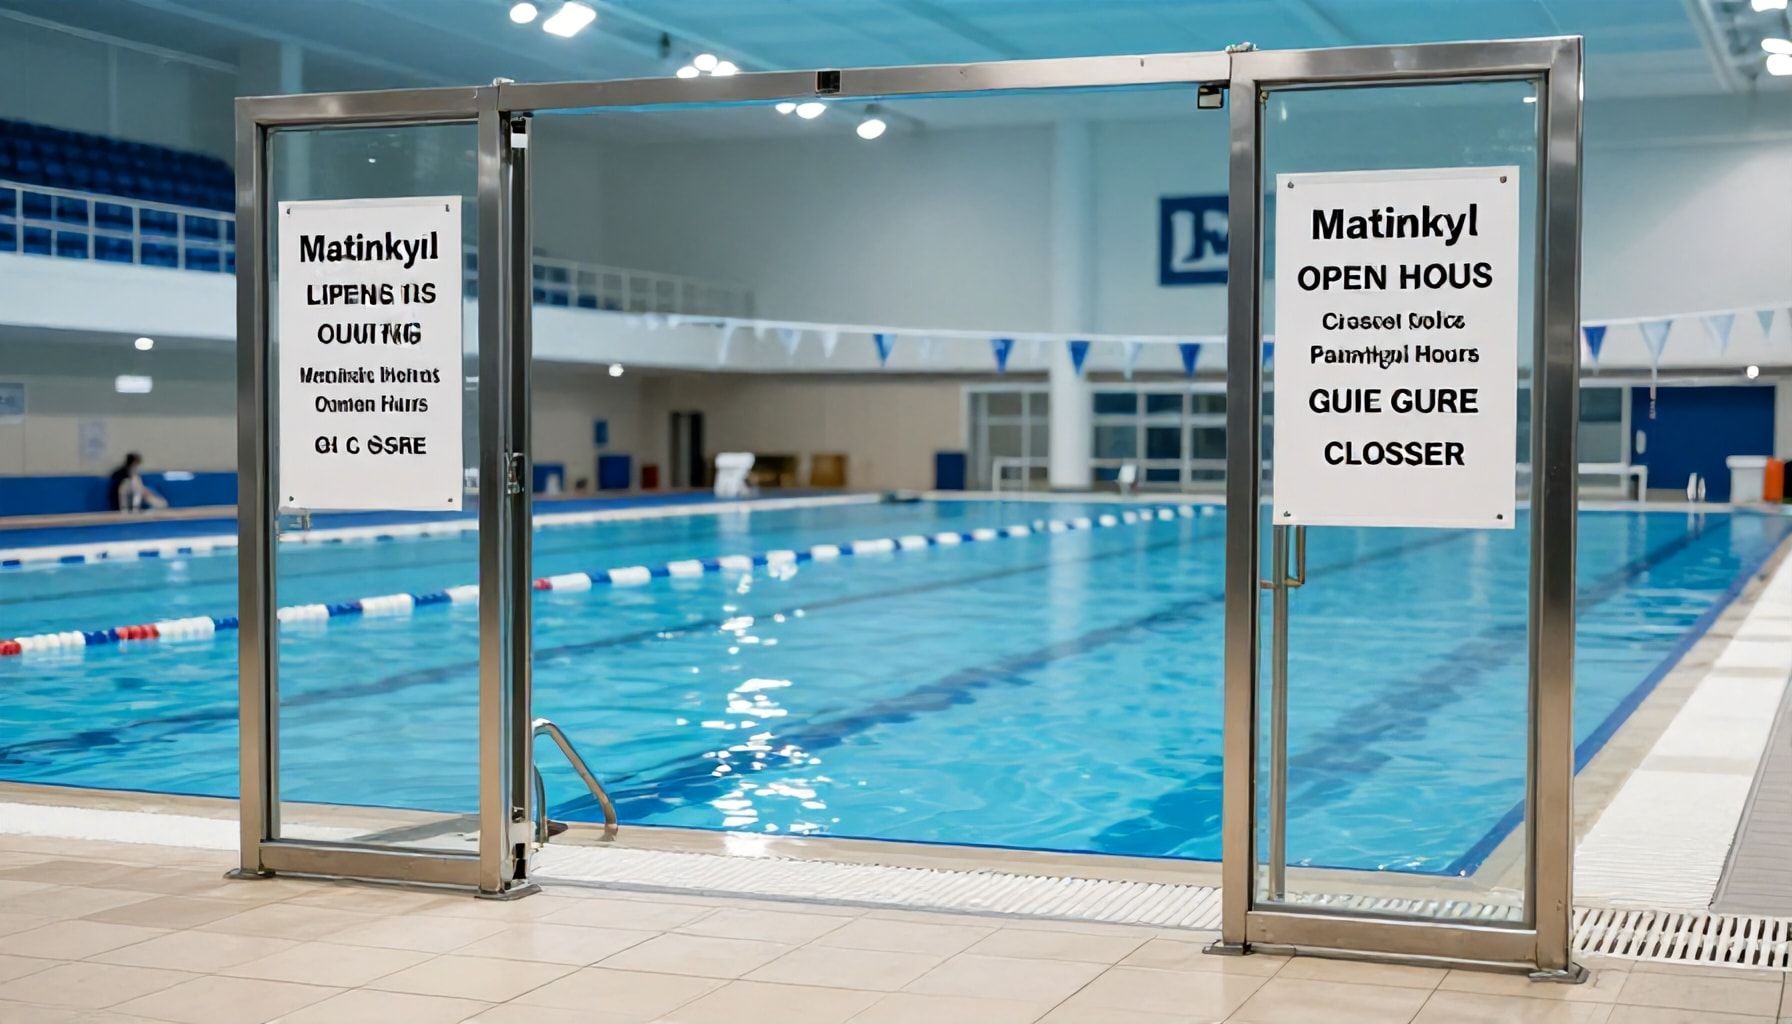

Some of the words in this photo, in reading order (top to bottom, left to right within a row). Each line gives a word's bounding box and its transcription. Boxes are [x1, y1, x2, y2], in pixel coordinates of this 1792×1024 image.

[1312, 203, 1479, 247] Matinkyl
[1297, 264, 1387, 292] OPEN
[1399, 262, 1493, 290] HOUS
[1415, 345, 1480, 364] Hours
[1308, 389, 1382, 414] GUIE
[1390, 389, 1479, 413] GURE
[1324, 440, 1465, 467] CLOSSER
